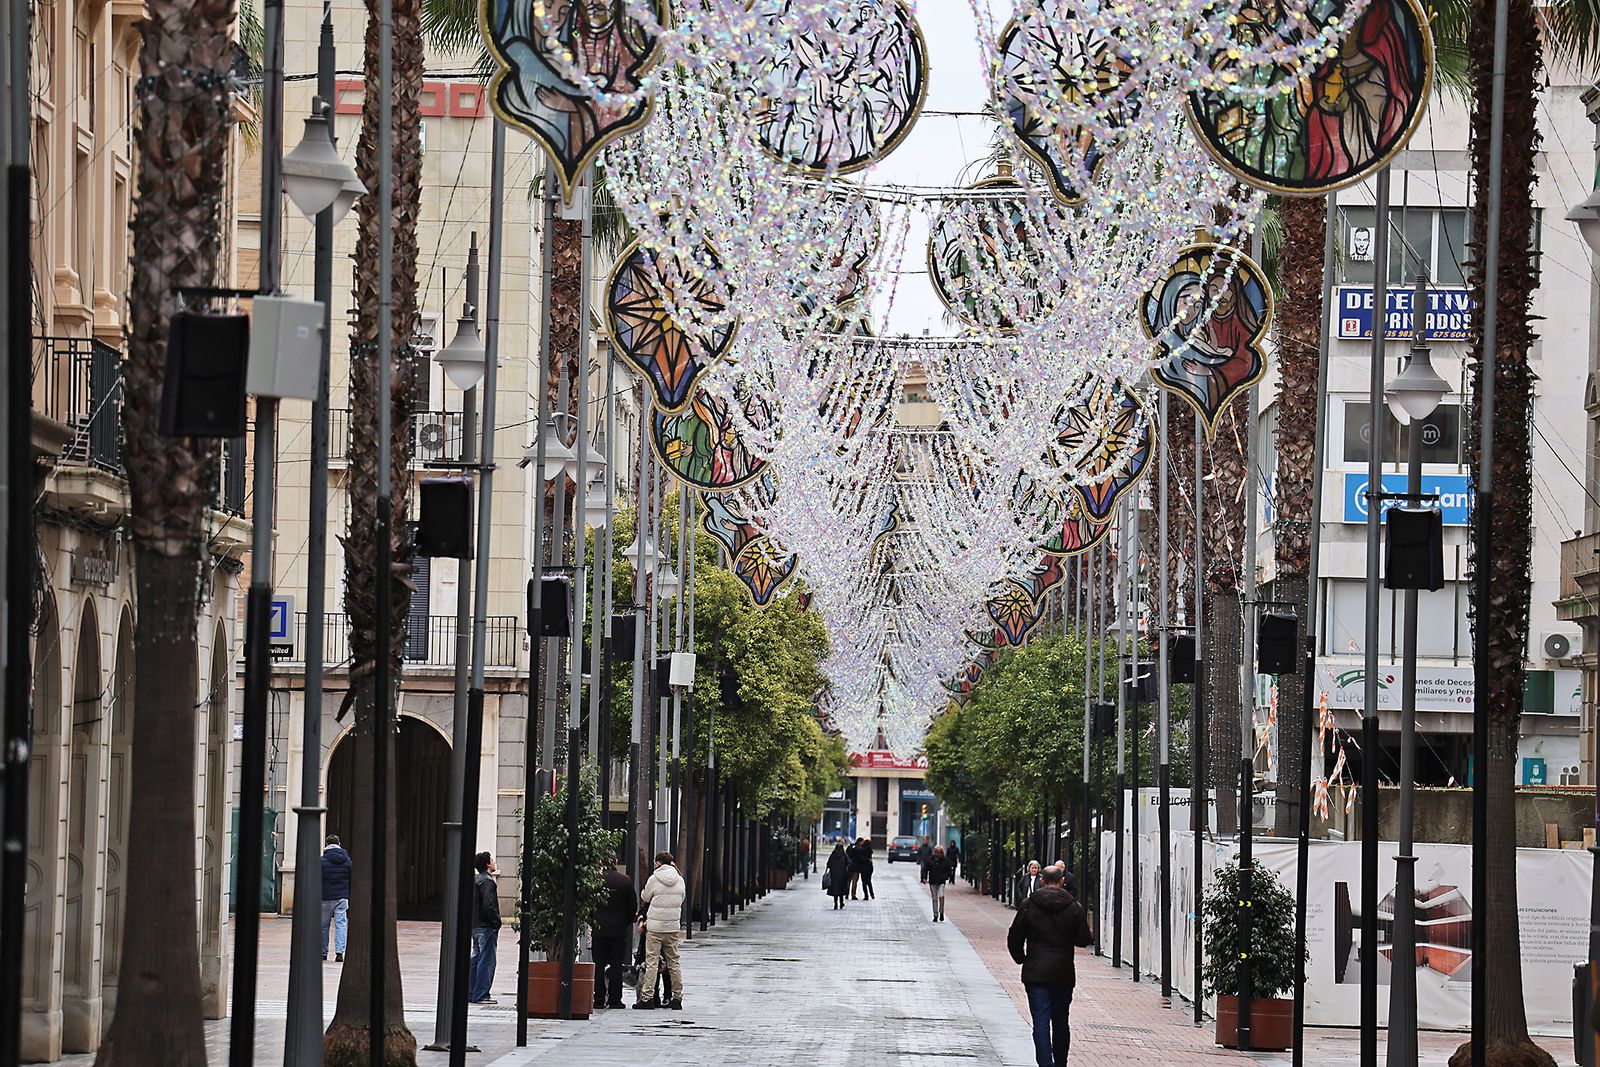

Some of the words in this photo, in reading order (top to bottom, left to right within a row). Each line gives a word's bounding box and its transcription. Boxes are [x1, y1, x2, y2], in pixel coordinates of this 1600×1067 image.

[1415, 687, 1448, 695] miliares
[1456, 688, 1474, 696] Pers
[1253, 797, 1276, 806] COTE
